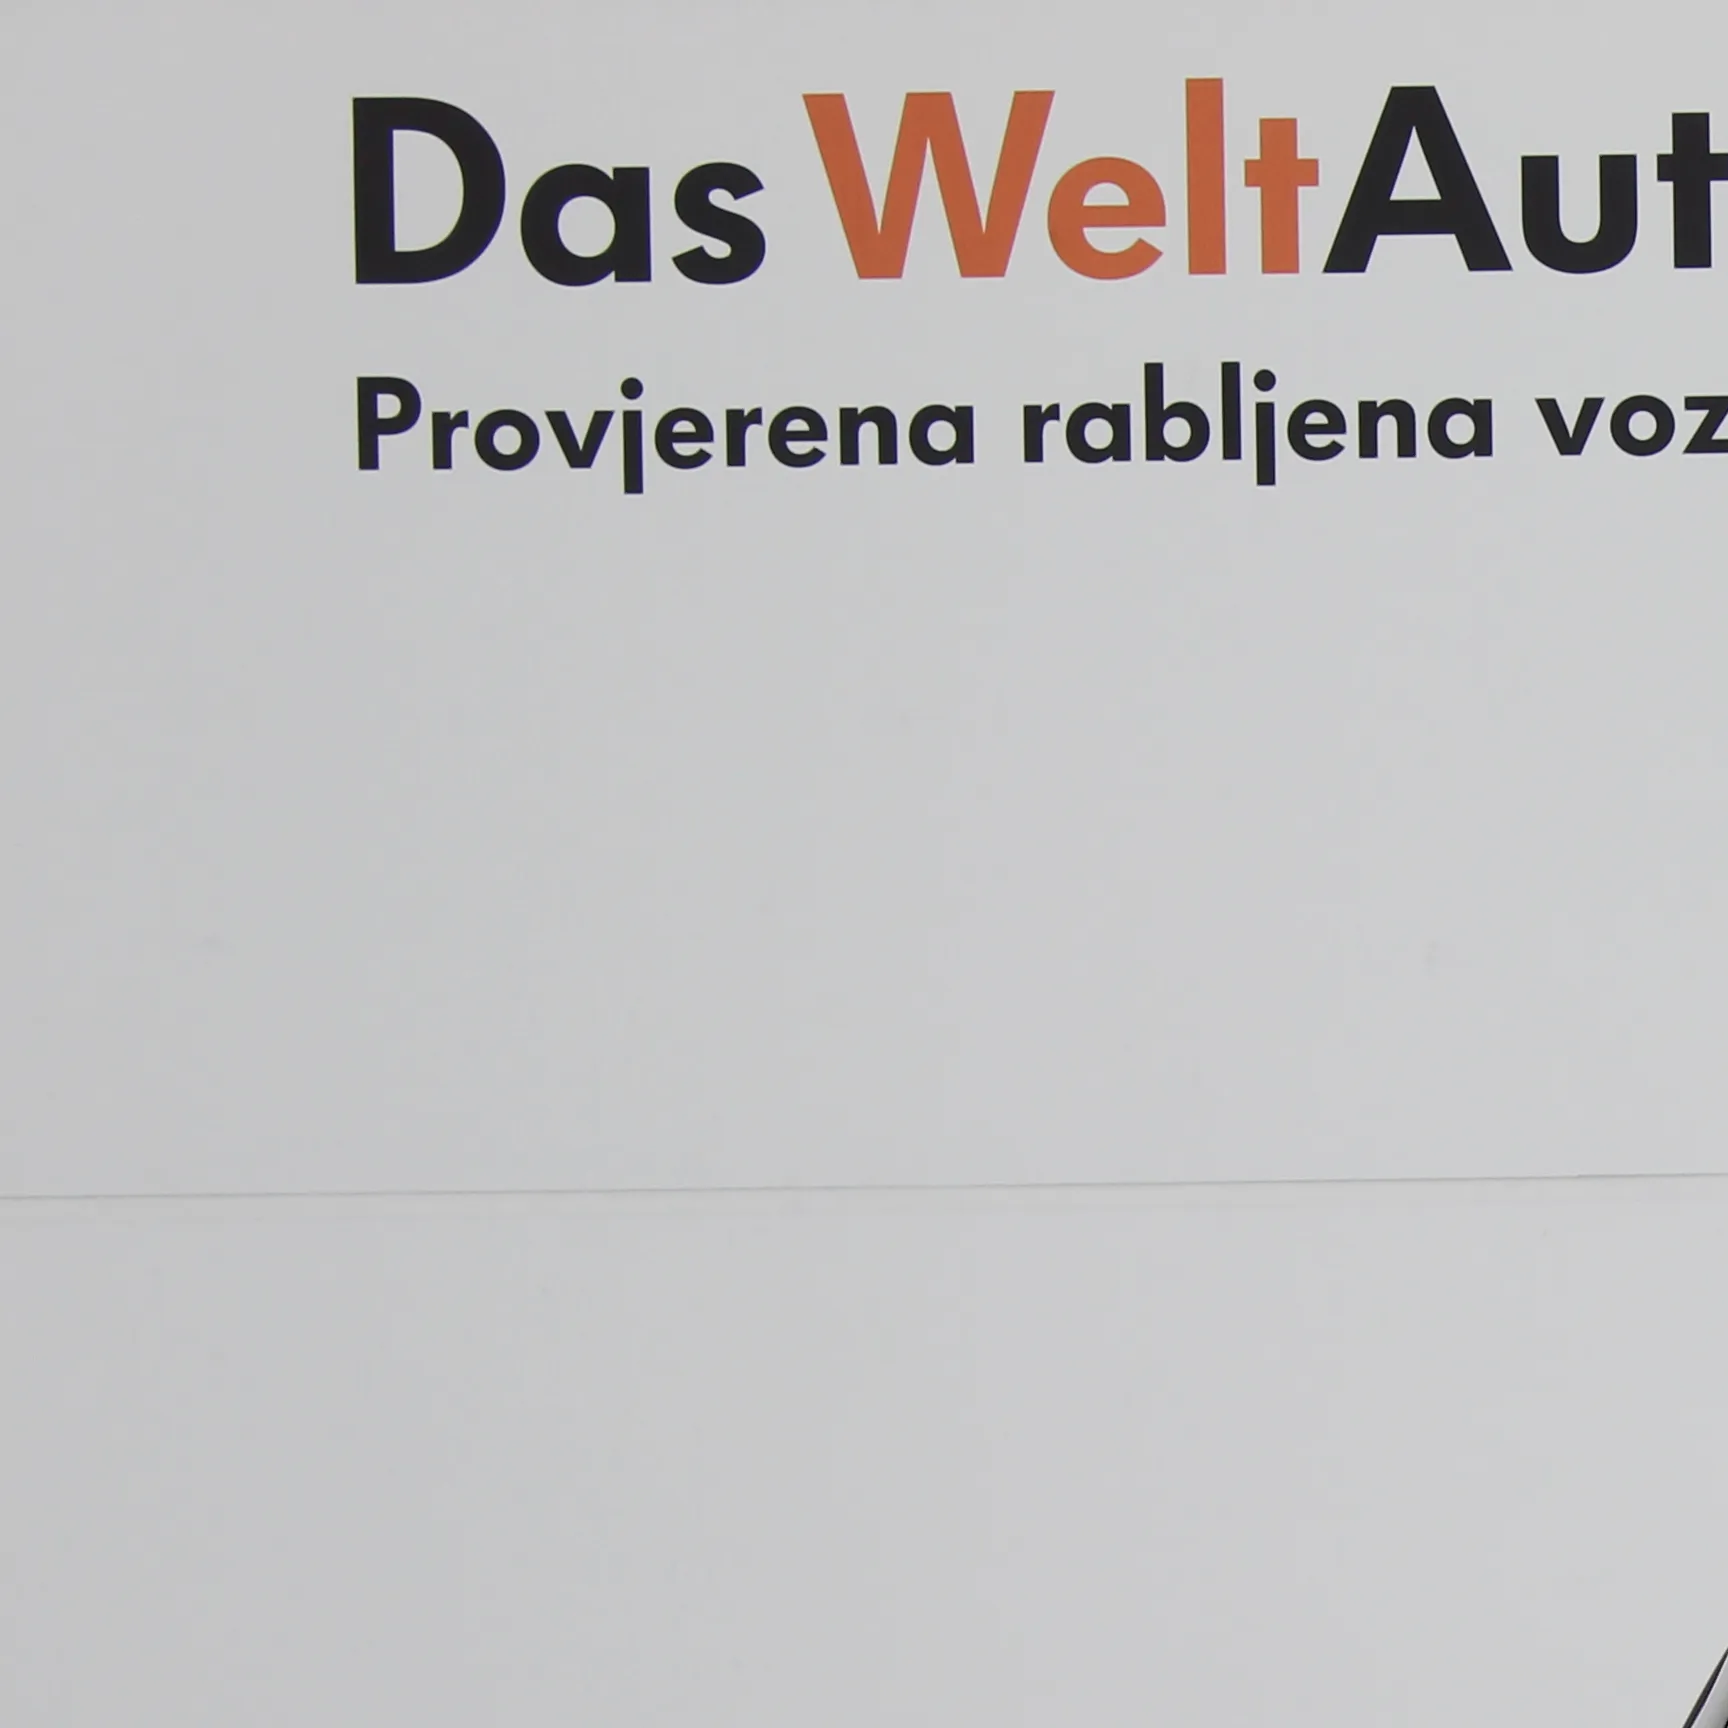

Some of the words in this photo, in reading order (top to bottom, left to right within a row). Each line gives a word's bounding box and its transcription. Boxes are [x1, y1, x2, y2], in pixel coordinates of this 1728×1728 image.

[353, 97, 767, 288] Das
[357, 377, 976, 496] Provjerena
[1024, 362, 1494, 487] rabljena
